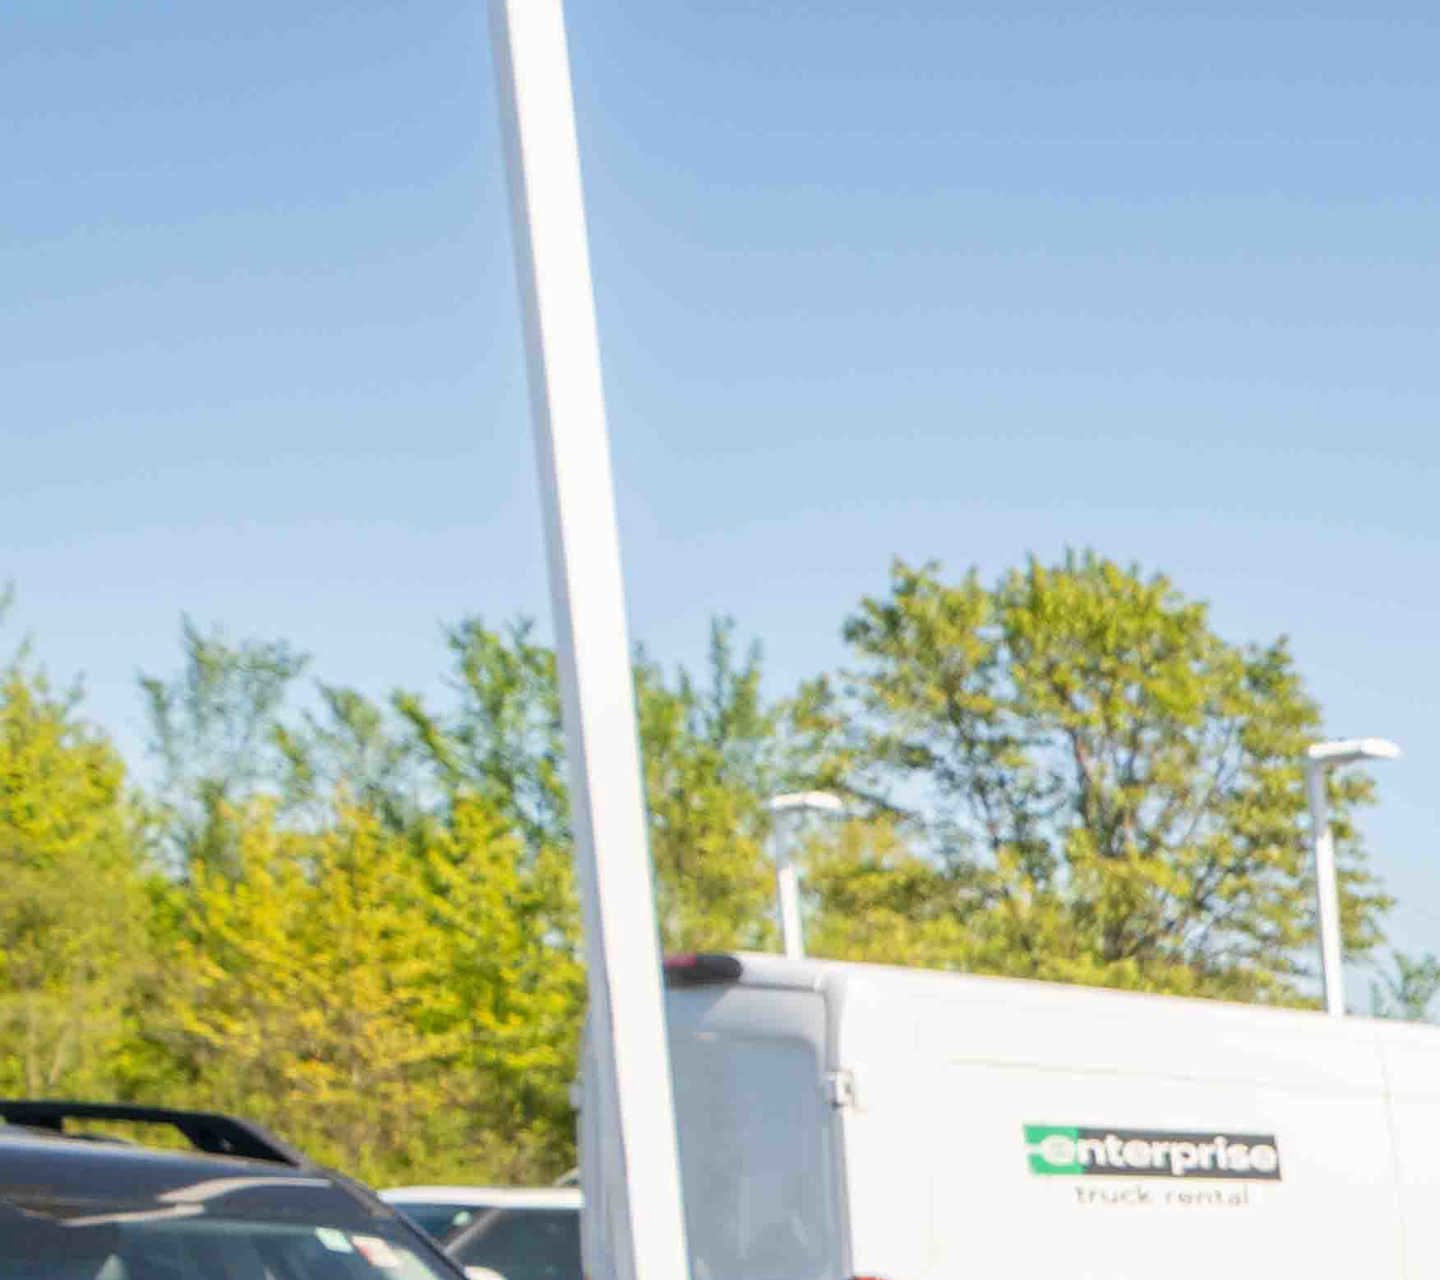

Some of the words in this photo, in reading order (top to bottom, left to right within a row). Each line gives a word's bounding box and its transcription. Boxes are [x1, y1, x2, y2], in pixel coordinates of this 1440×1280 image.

[1024, 1132, 1279, 1176] enterprise
[1074, 1185, 1150, 1206] truck
[1165, 1185, 1250, 1206] rental
